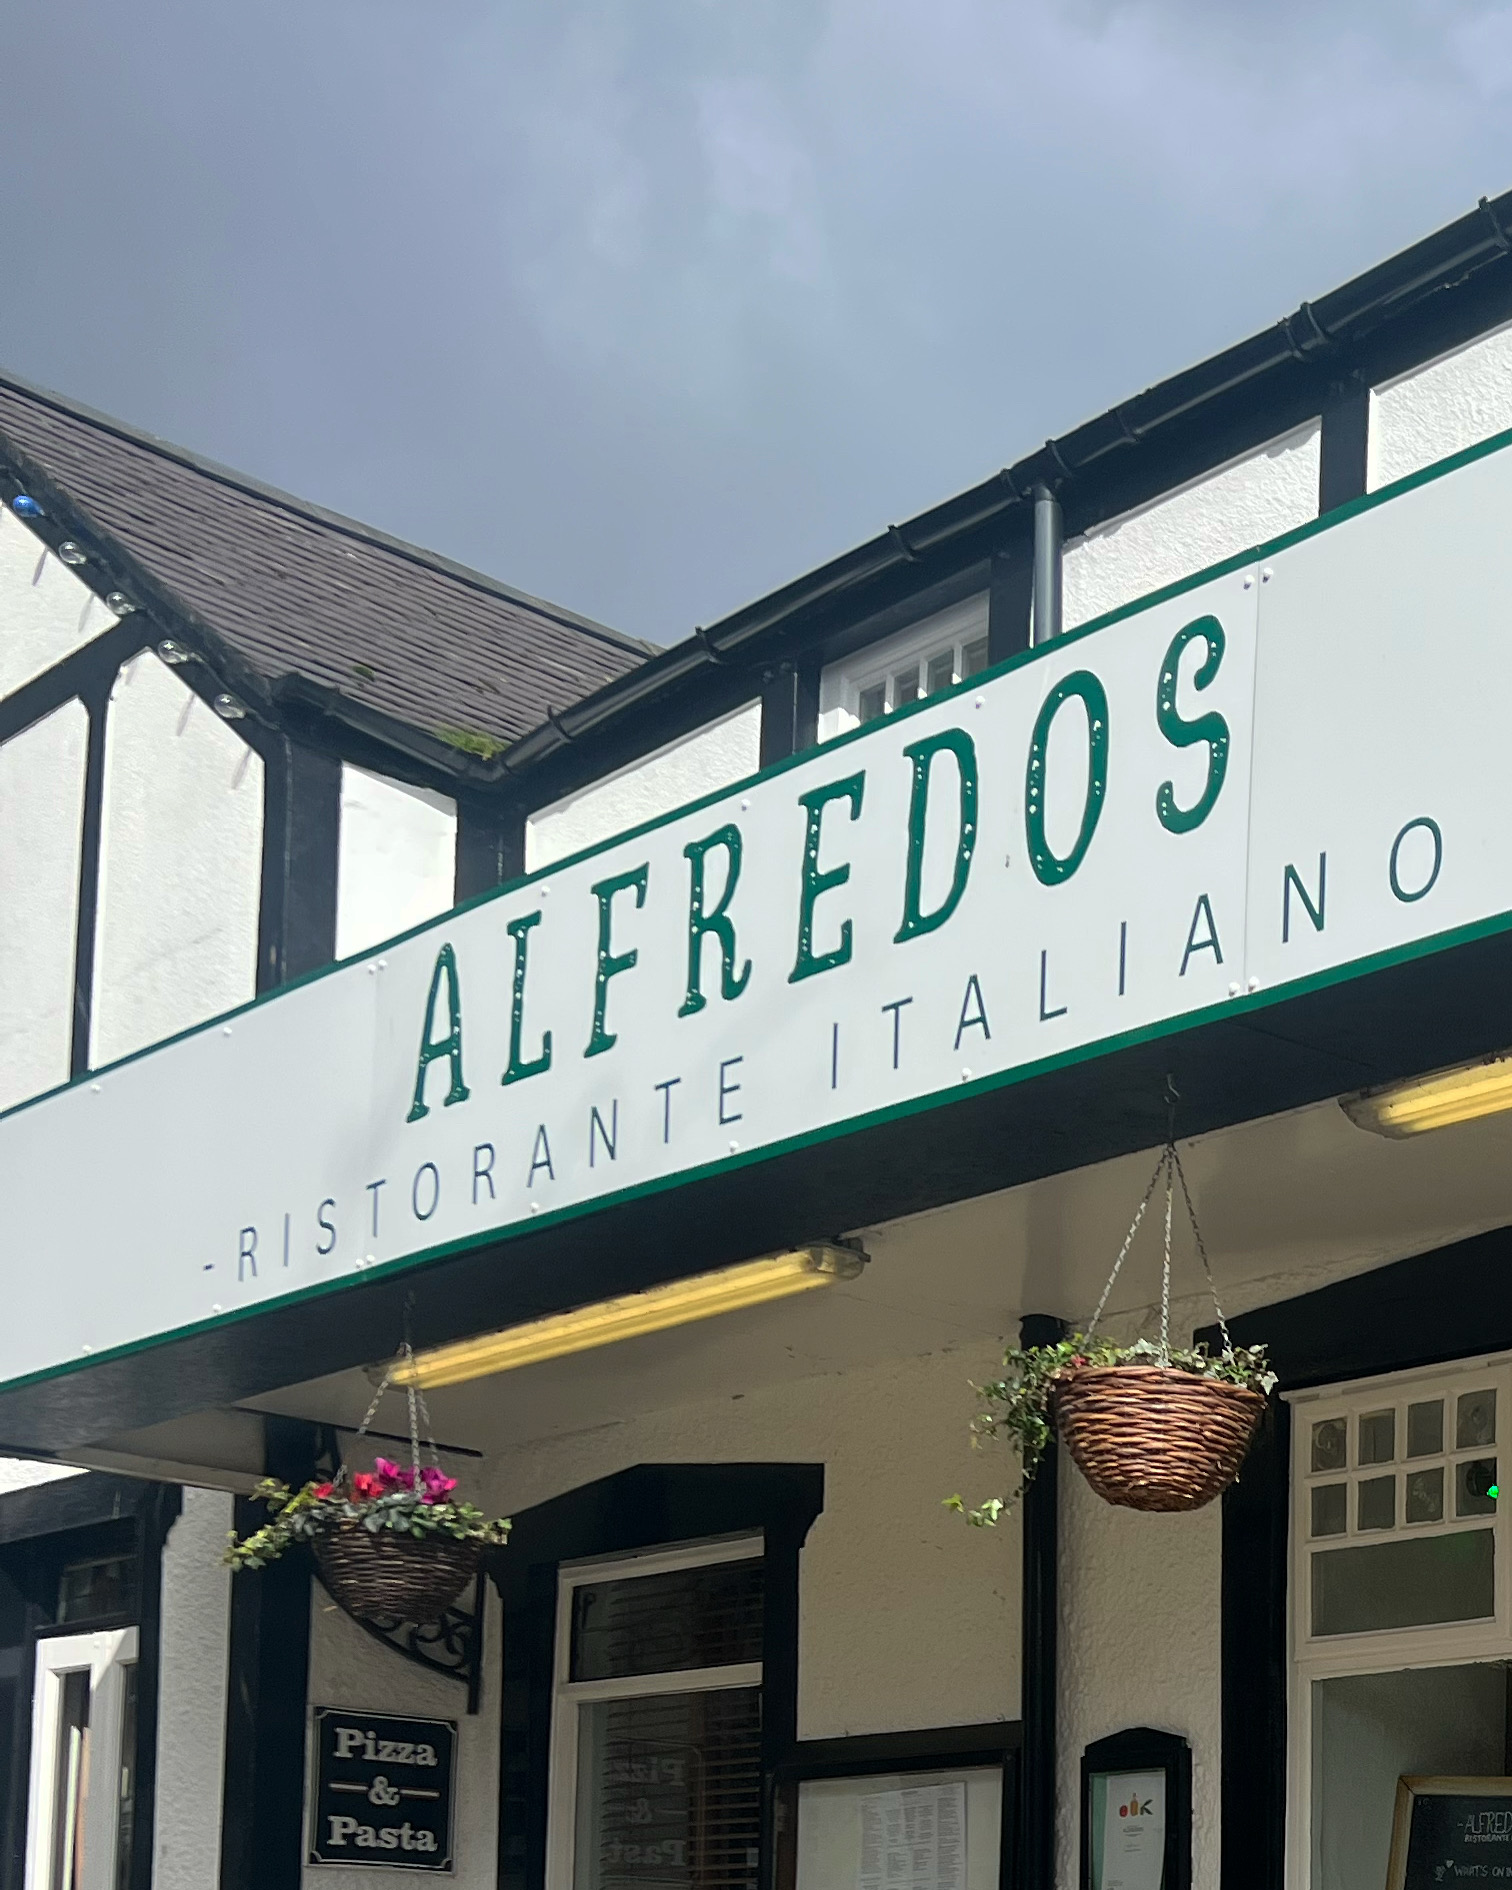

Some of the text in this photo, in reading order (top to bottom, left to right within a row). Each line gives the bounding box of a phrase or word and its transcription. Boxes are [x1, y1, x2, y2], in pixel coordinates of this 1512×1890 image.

[406, 614, 1231, 1123] ALFREDOS
[829, 816, 1444, 1091] ITALIANO
[333, 1727, 438, 1766] Pizza
[368, 1775, 400, 1806] &
[327, 1815, 438, 1852] Pasta
